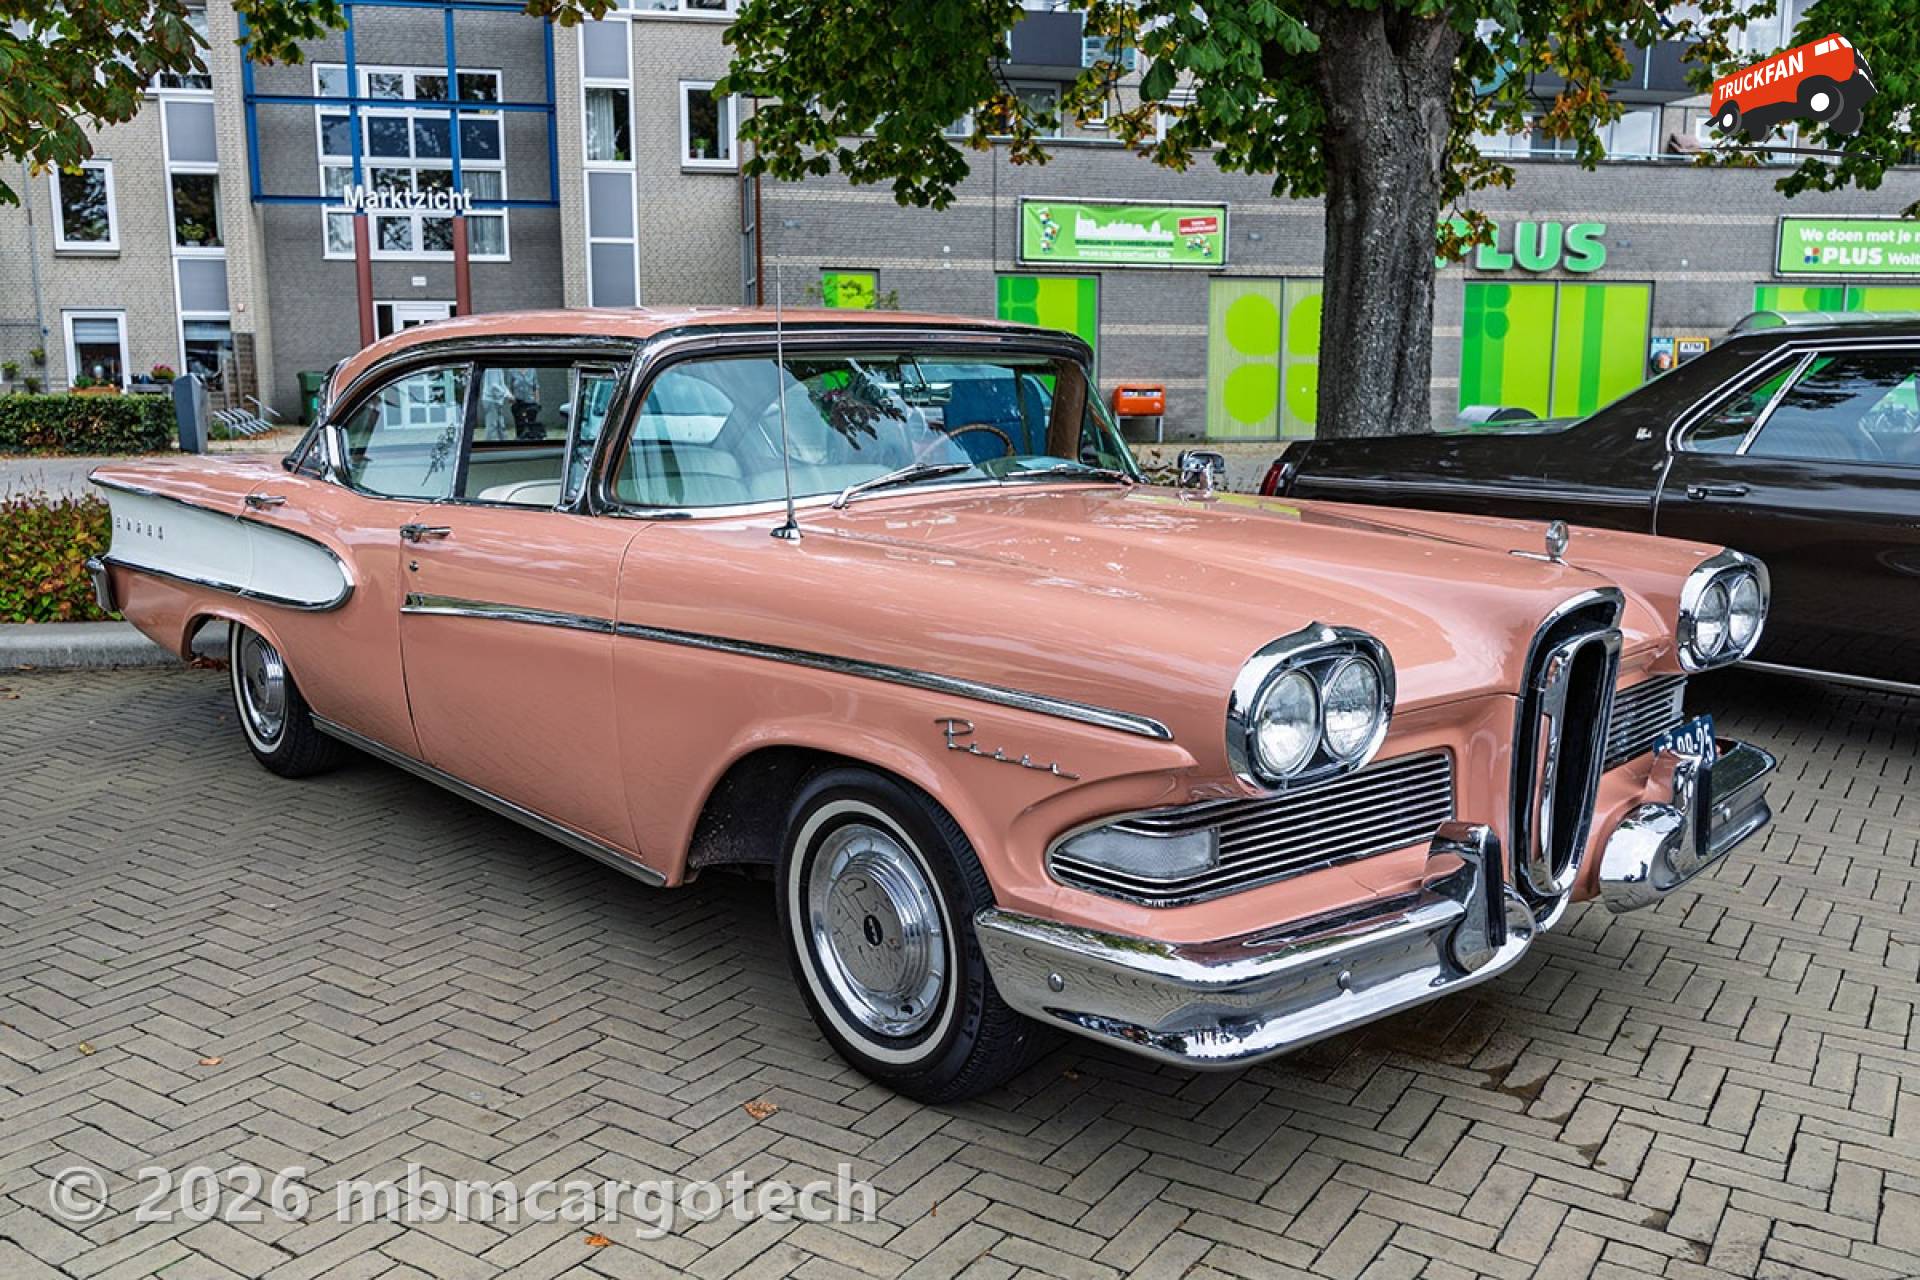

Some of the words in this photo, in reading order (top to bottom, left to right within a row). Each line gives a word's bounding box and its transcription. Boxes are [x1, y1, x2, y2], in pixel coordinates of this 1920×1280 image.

[343, 184, 472, 210] Marktzicht
[1800, 228, 1824, 241] We
[1826, 228, 1863, 242] doen
[1866, 229, 1895, 242] met
[1822, 247, 1883, 265] PLUS
